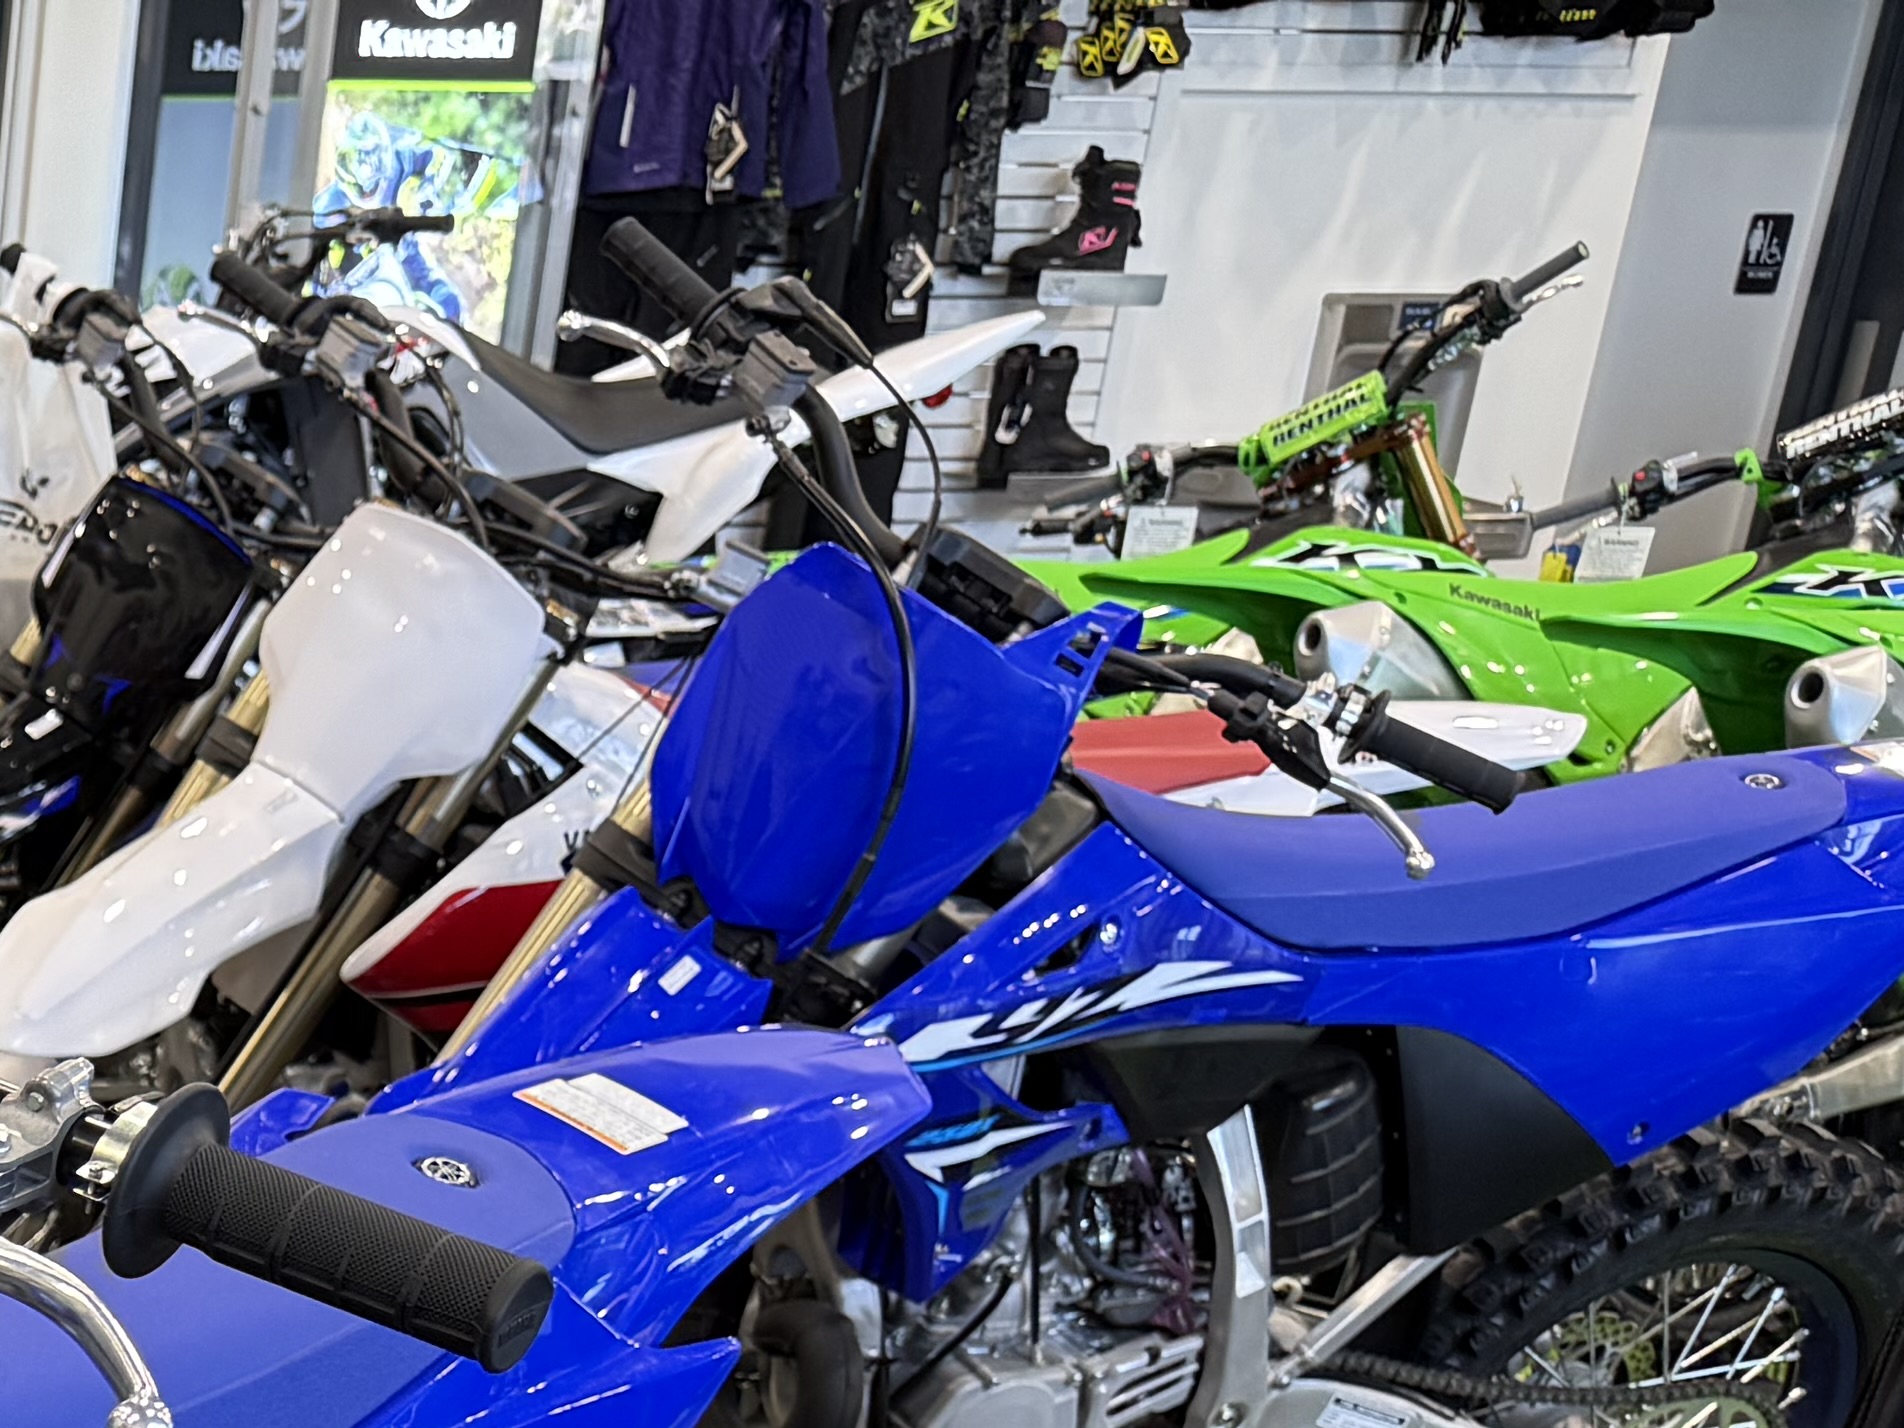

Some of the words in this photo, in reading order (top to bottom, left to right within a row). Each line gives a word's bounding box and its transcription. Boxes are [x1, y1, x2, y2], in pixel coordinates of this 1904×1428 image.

[358, 20, 517, 58] Kawasaki
[1272, 392, 1367, 448] RENTHAL
[1448, 582, 1541, 622] Kawasaki
